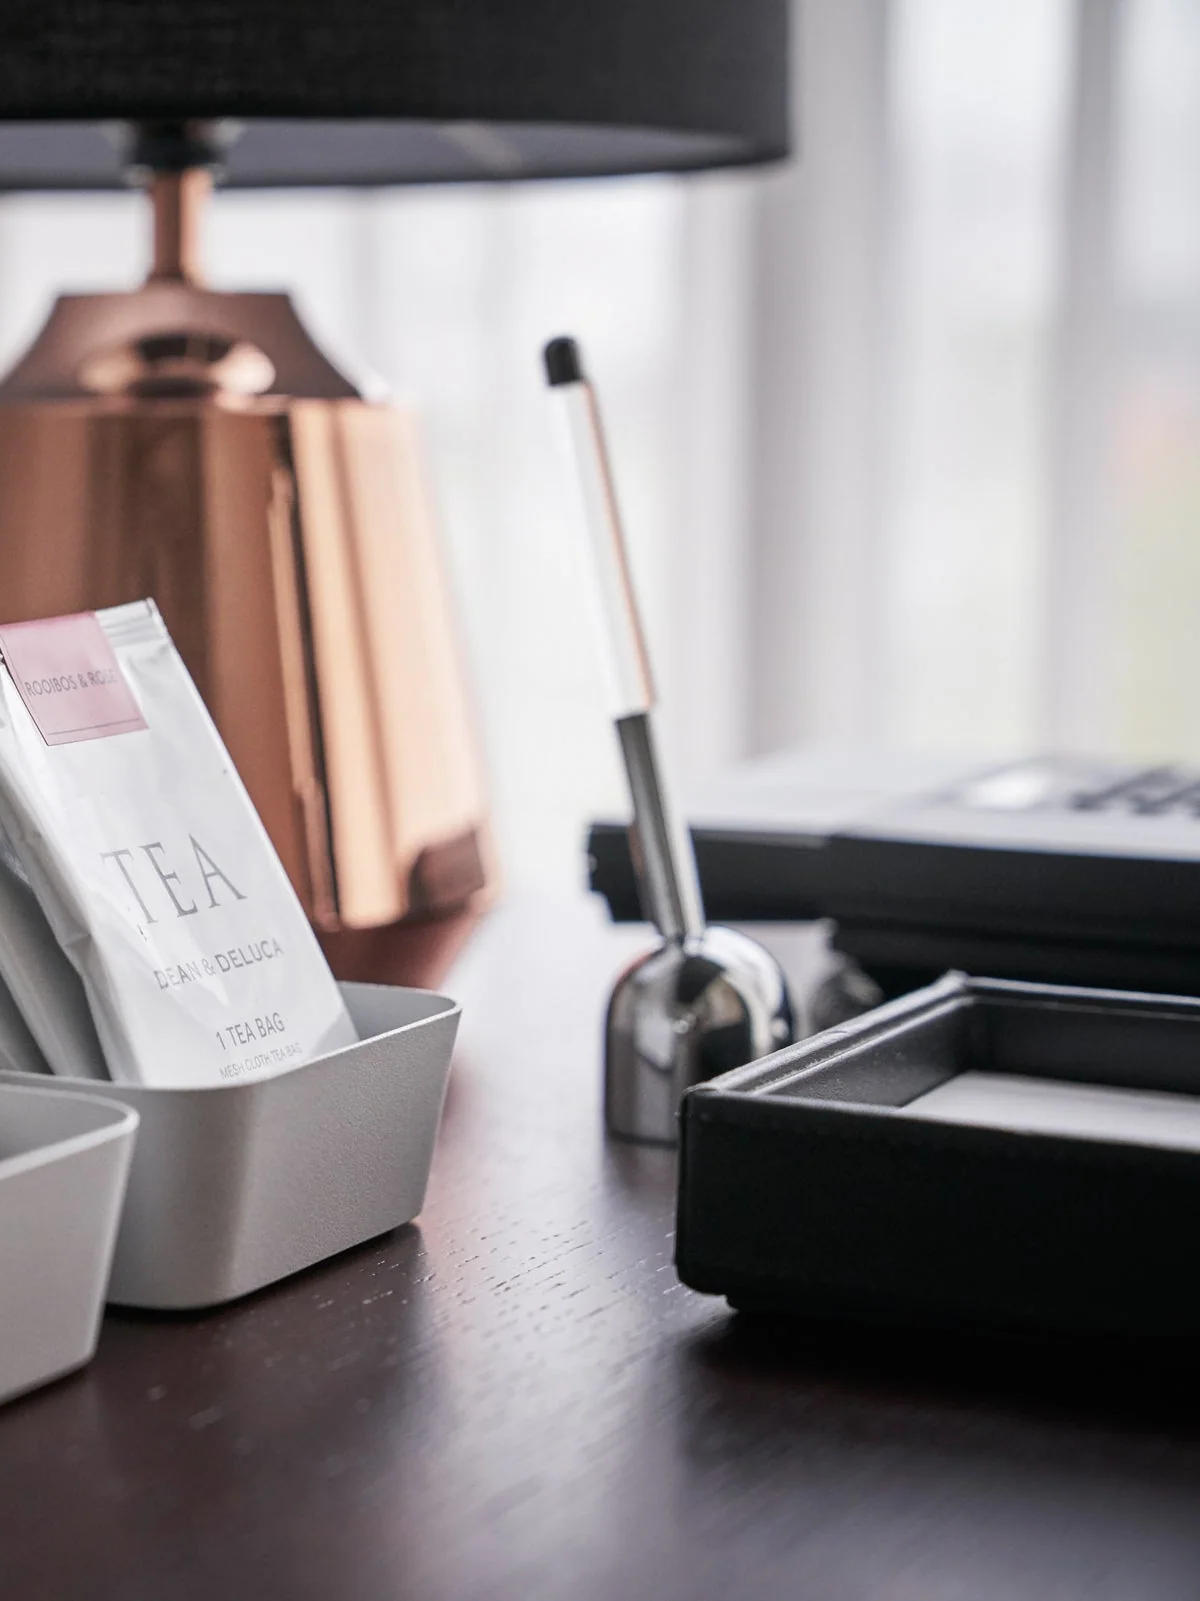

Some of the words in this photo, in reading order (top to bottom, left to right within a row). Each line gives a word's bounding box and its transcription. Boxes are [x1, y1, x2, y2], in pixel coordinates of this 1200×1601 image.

[24, 675, 78, 697] ROOIBOS
[77, 673, 89, 689] &
[99, 833, 248, 924] TEA
[153, 961, 202, 990] DEAN
[201, 958, 216, 976] &
[214, 938, 284, 973] DELUCA
[216, 1031, 226, 1050] 1
[225, 1022, 256, 1046] TEA
[255, 1012, 285, 1038] BAG
[219, 1062, 246, 1079] MESH
[244, 1053, 272, 1071] CLOTH
[270, 1047, 287, 1062] TEA
